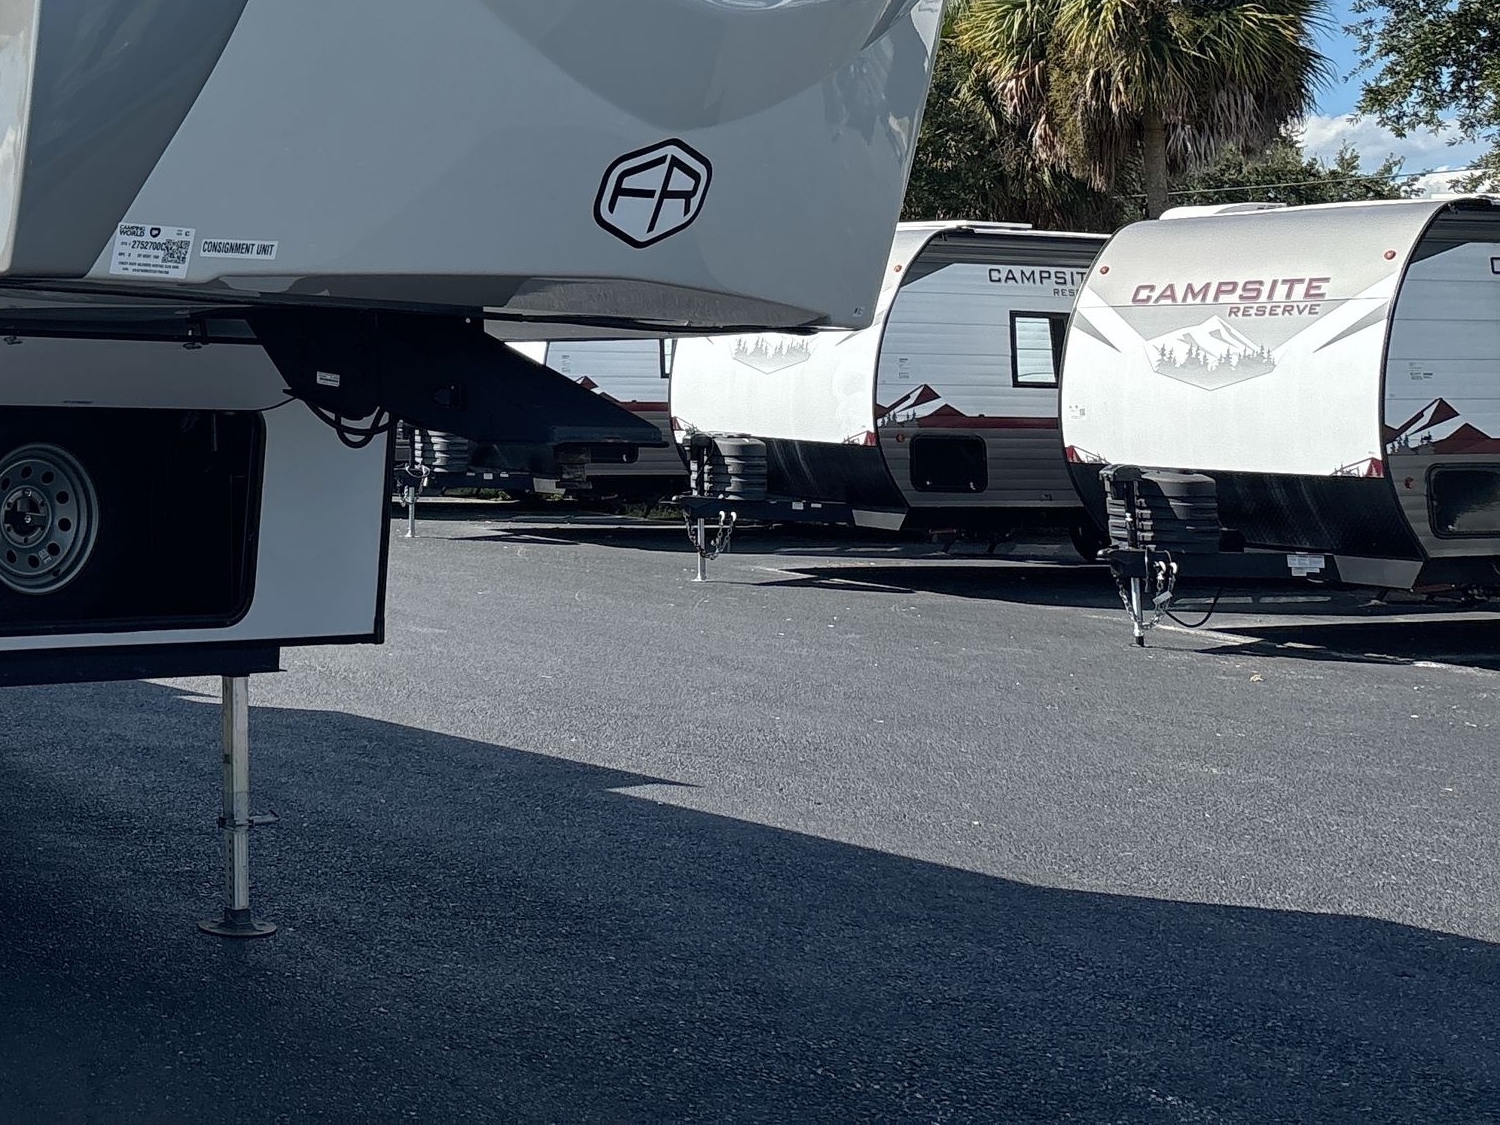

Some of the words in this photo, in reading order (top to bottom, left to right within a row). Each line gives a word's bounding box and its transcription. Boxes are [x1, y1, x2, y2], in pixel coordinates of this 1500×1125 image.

[202, 240, 255, 255] CONSIGNMENT
[256, 243, 275, 256] UNIT
[988, 268, 1087, 286] CAMPSIT
[1131, 277, 1331, 304] CAMPSITE
[1228, 303, 1321, 318] RESERVE
